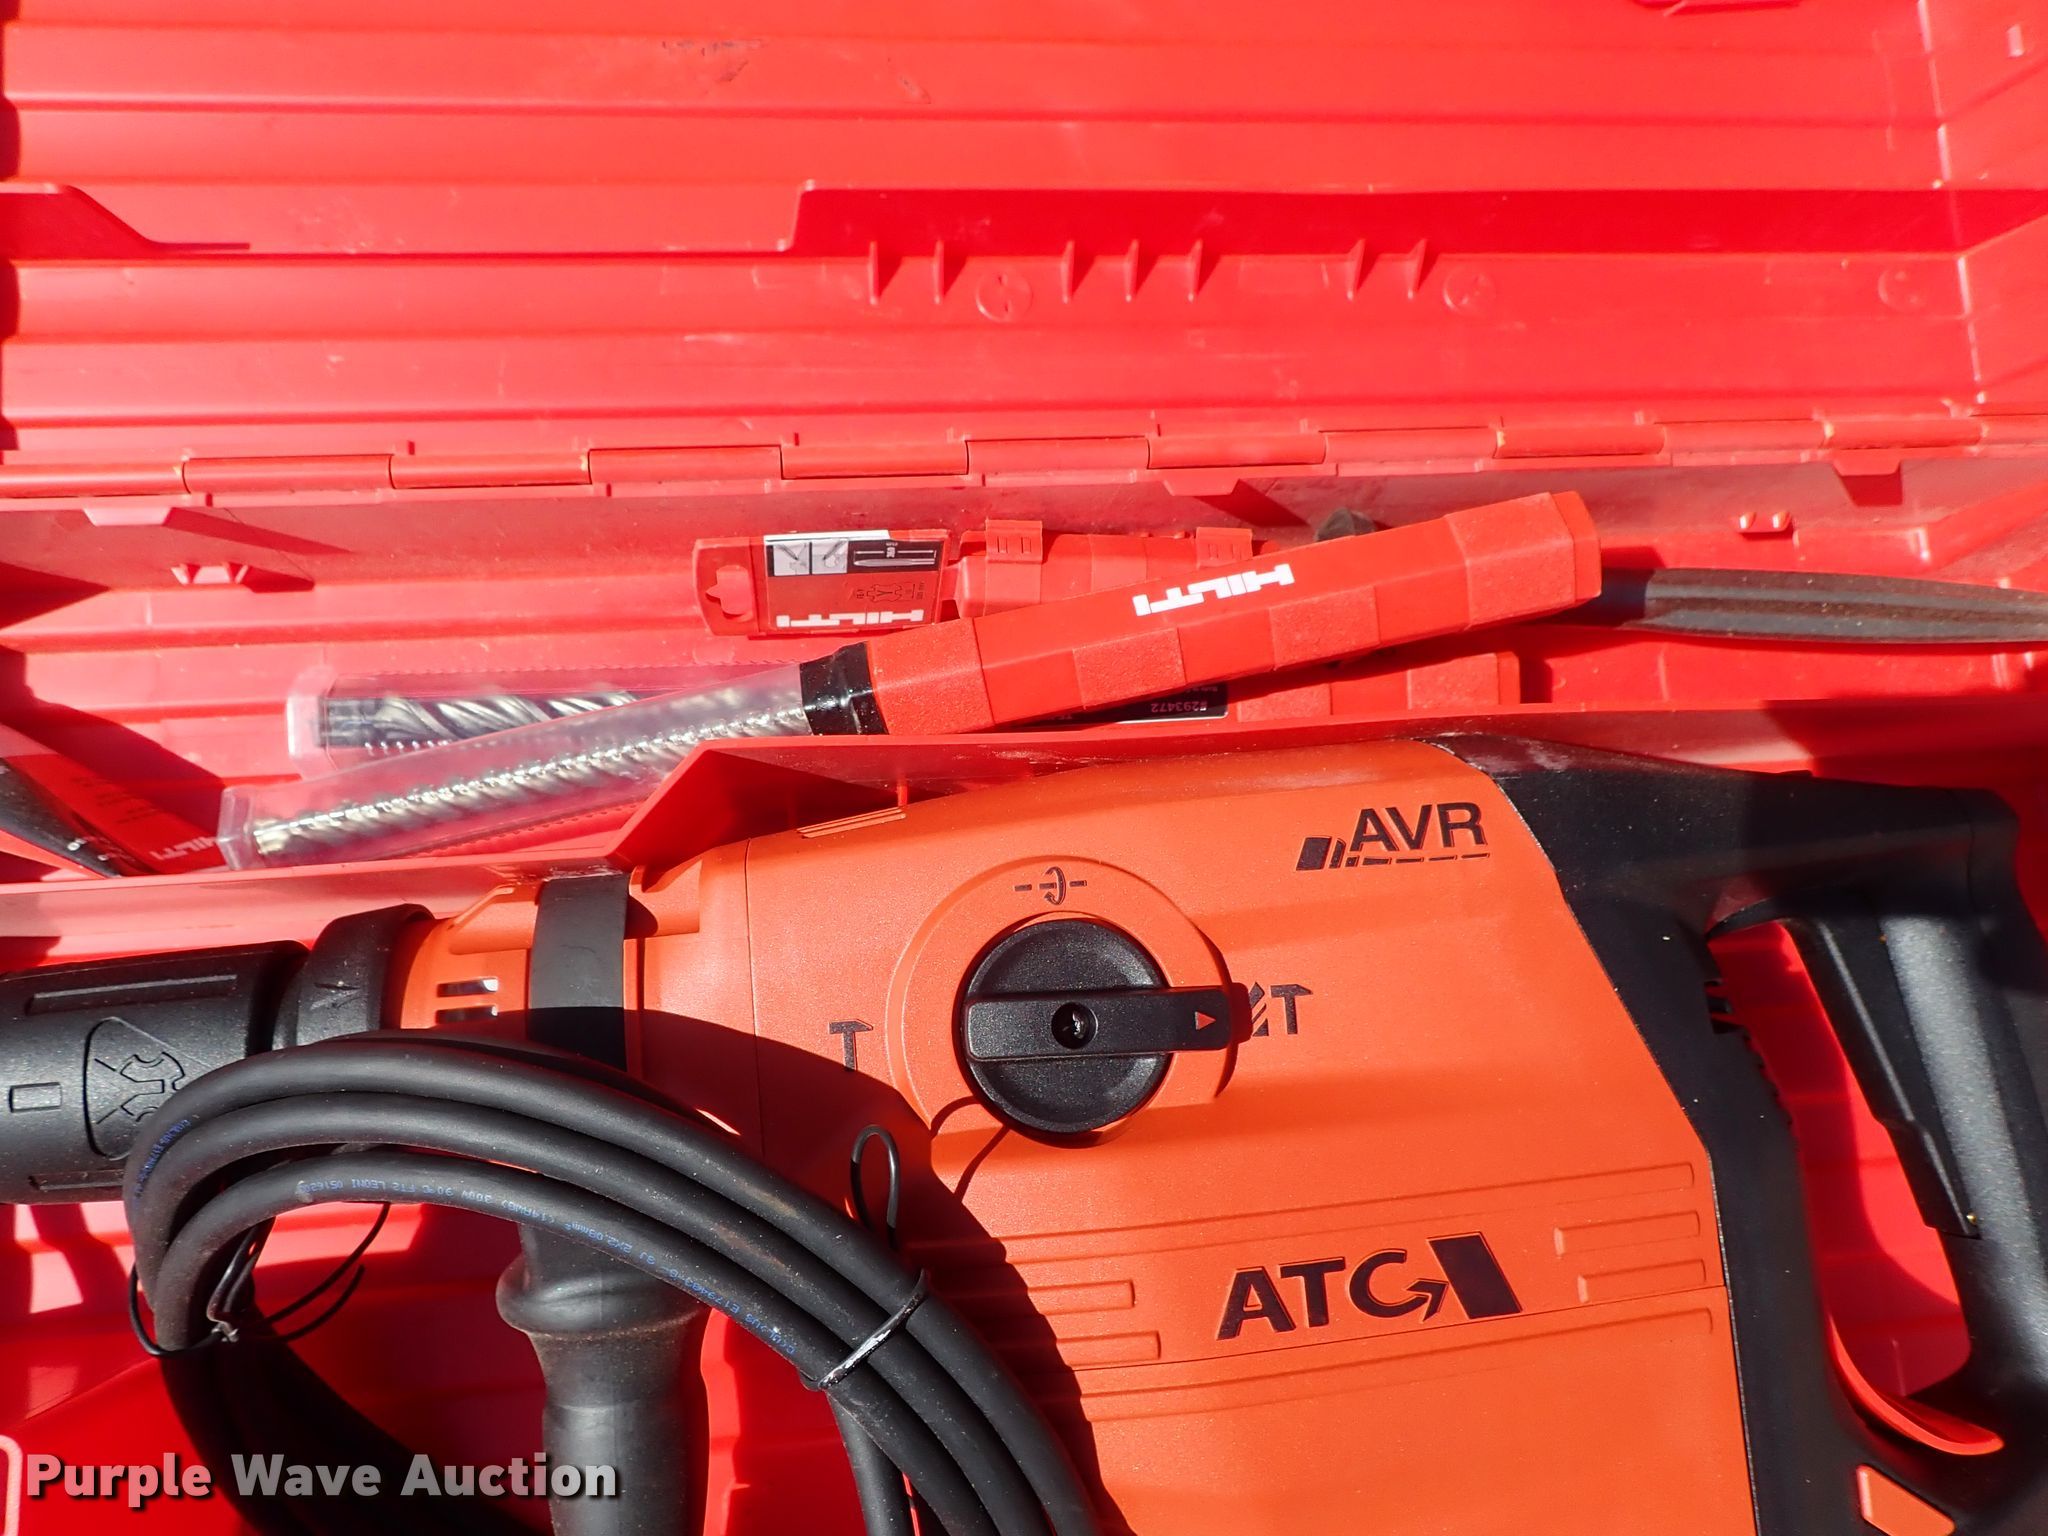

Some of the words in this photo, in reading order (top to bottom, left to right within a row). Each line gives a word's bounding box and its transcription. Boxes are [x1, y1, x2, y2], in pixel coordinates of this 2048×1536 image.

[1132, 563, 1295, 617] HILTI
[776, 609, 925, 628] HILTI
[1350, 802, 1488, 852] AVR
[351, 1178, 386, 1190] LEONI
[1216, 1247, 1449, 1341] ATC
